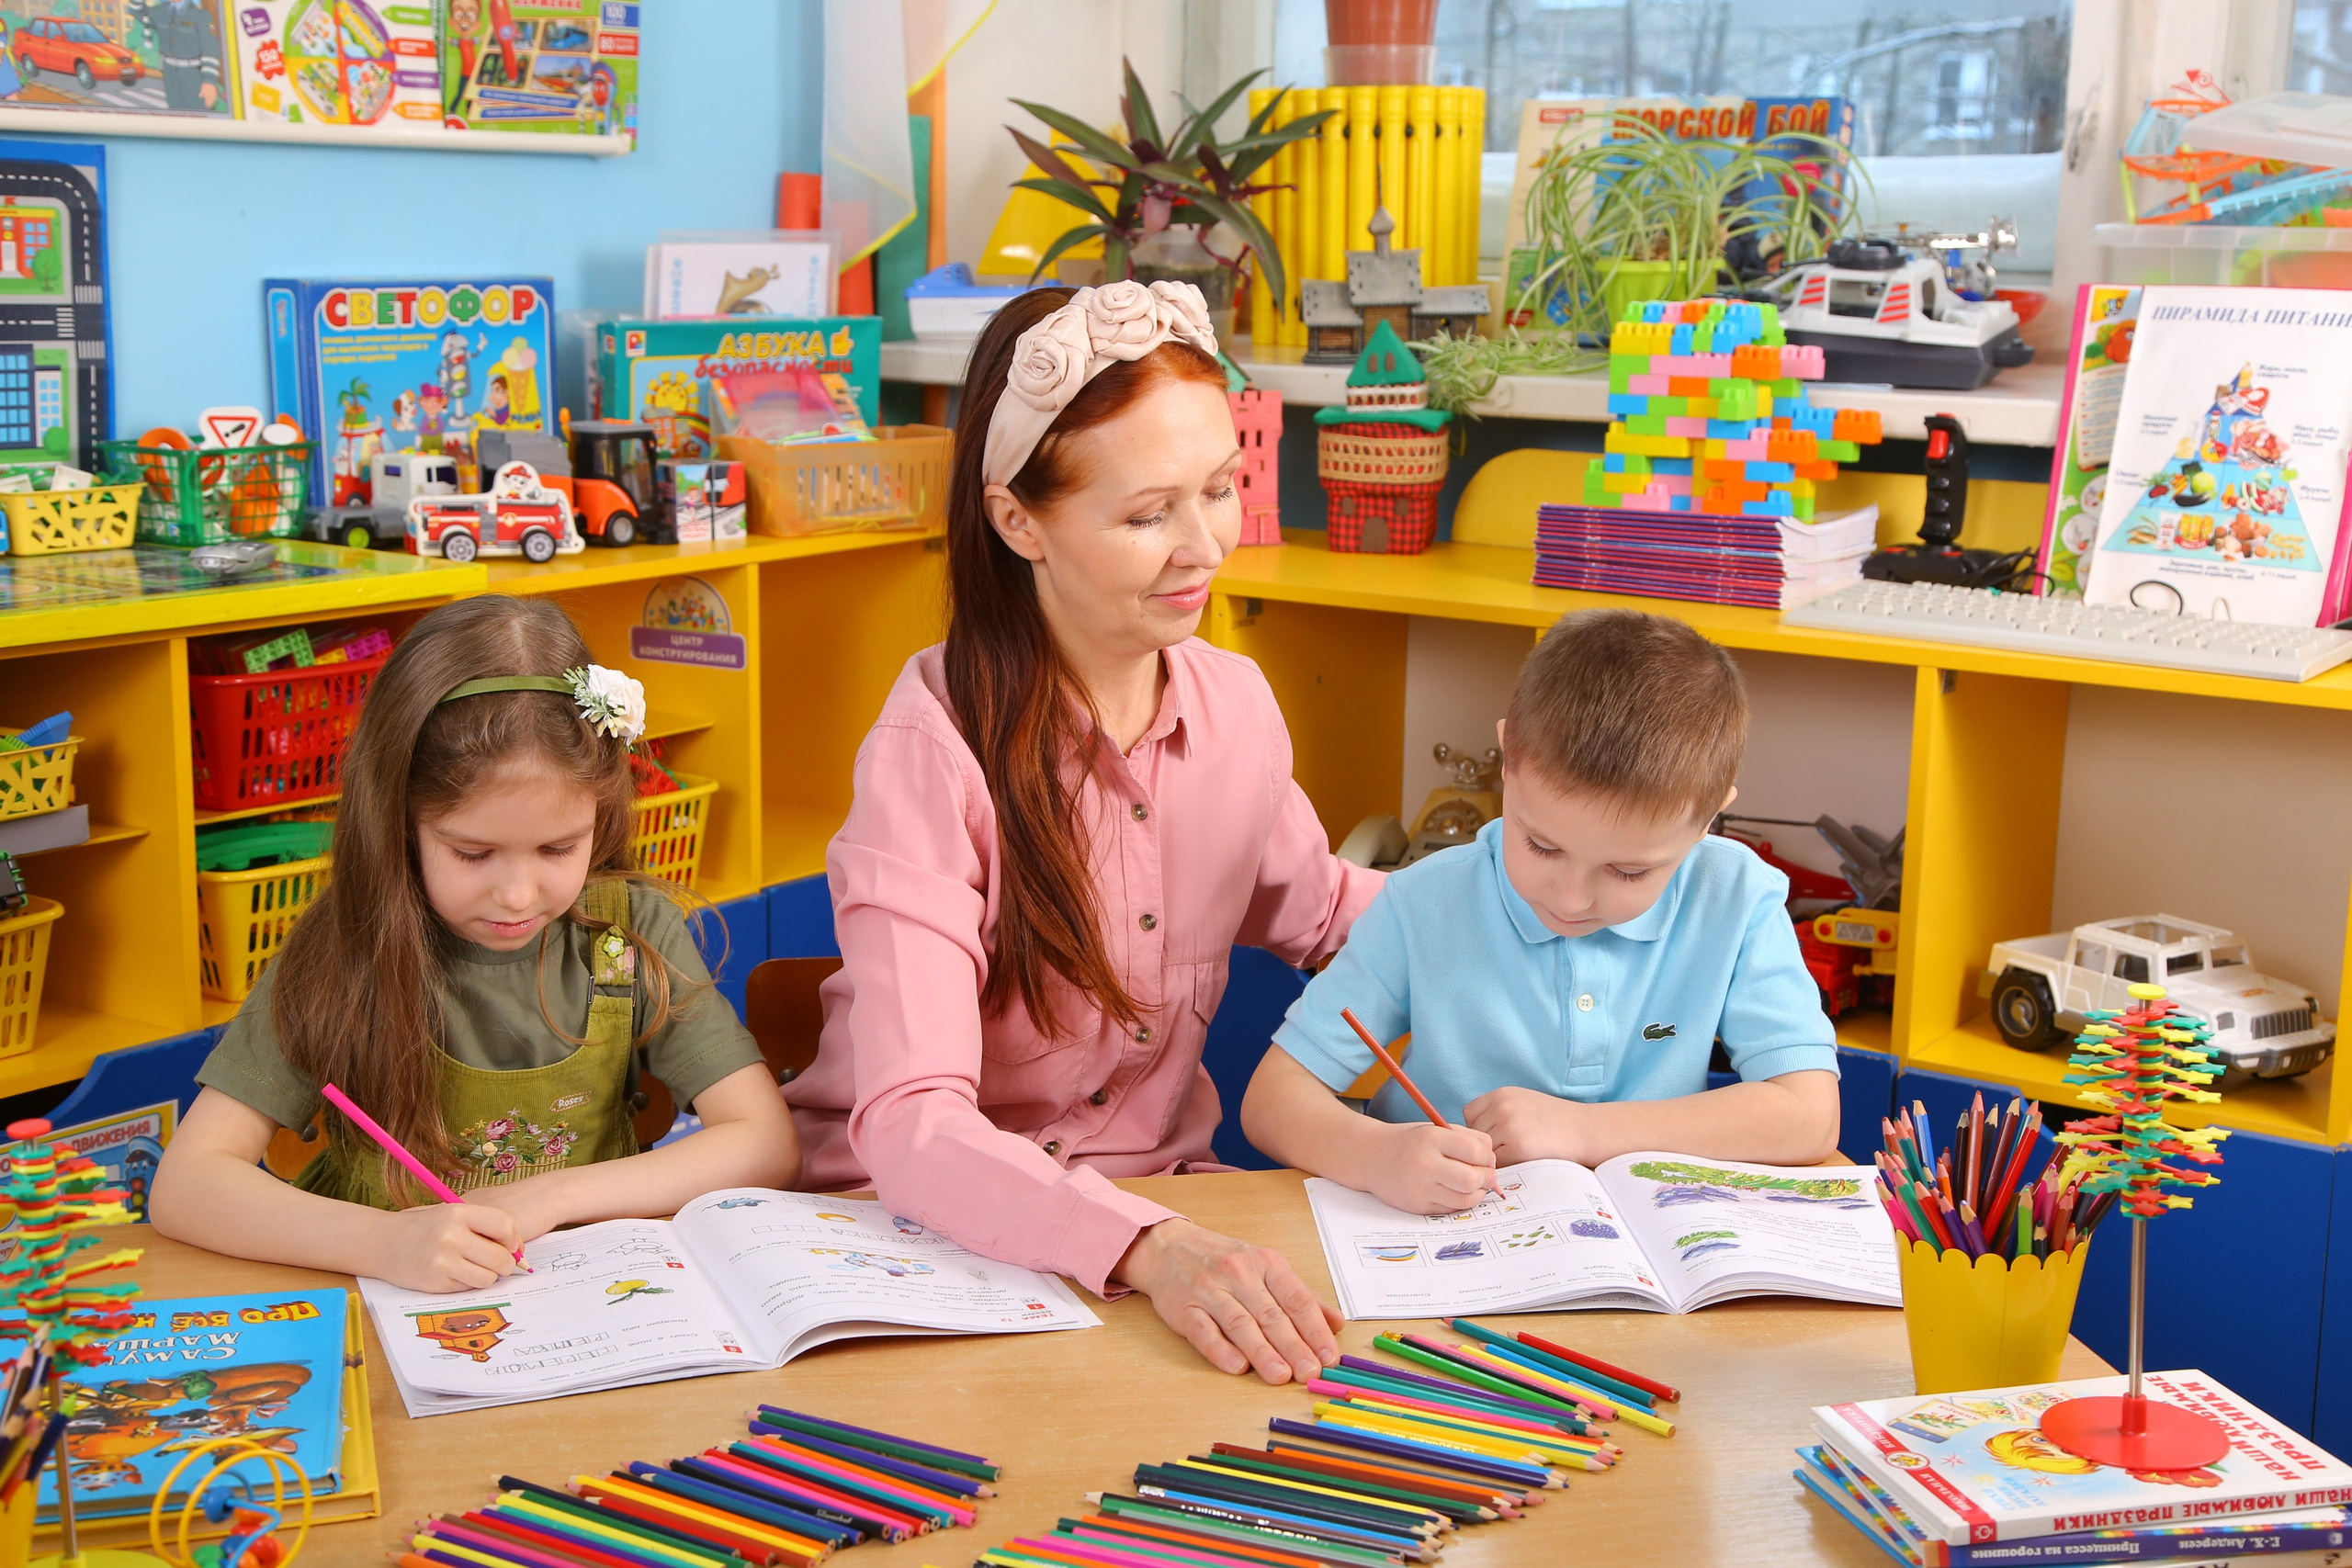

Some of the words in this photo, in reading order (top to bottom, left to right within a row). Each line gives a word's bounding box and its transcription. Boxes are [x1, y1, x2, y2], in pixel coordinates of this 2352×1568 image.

[1767, 100, 1830, 137] БОЙ
[325, 288, 535, 326] СВЕТОФОР
[2152, 306, 2260, 324] ПИРАМИДА
[2265, 310, 2352, 328] ПИТАНИ
[718, 332, 826, 360] АЗБУКА
[671, 635, 704, 647] ЦЕНТР
[639, 646, 737, 664] КОНСТРУИРОВАНИЯ
[71, 1121, 151, 1152] ДВИЖЕНИЯ
[590, 1270, 622, 1280] Курочку
[1530, 1272, 1555, 1280] Гроза
[1458, 1285, 1502, 1293] Листопад
[761, 1292, 782, 1307] дело
[767, 1294, 803, 1315] добрым
[238, 1301, 321, 1324] ПРО
[170, 1311, 230, 1333] ВСЁ
[646, 1318, 688, 1326] Посадил
[88, 1332, 242, 1351] МАРША
[590, 1361, 625, 1371] строчки
[629, 1353, 663, 1361] допиши
[1938, 1405, 1980, 1421] января
[1842, 1406, 1895, 1449] БИБЛИОТЕКА
[2178, 1382, 2328, 1470] ПРАЗДНИКИ
[1919, 1472, 1973, 1511] ШКОЛЬНАЯ
[2182, 1495, 2287, 1517] ЛЮБИМЫЕ
[2052, 1506, 2174, 1530] ПРАЗДНИКИ
[1971, 1546, 2041, 1559] горошине
[2044, 1547, 2063, 1555] на
[2064, 1541, 2140, 1556] Принцесса
[2178, 1537, 2246, 1550] Андерсен
